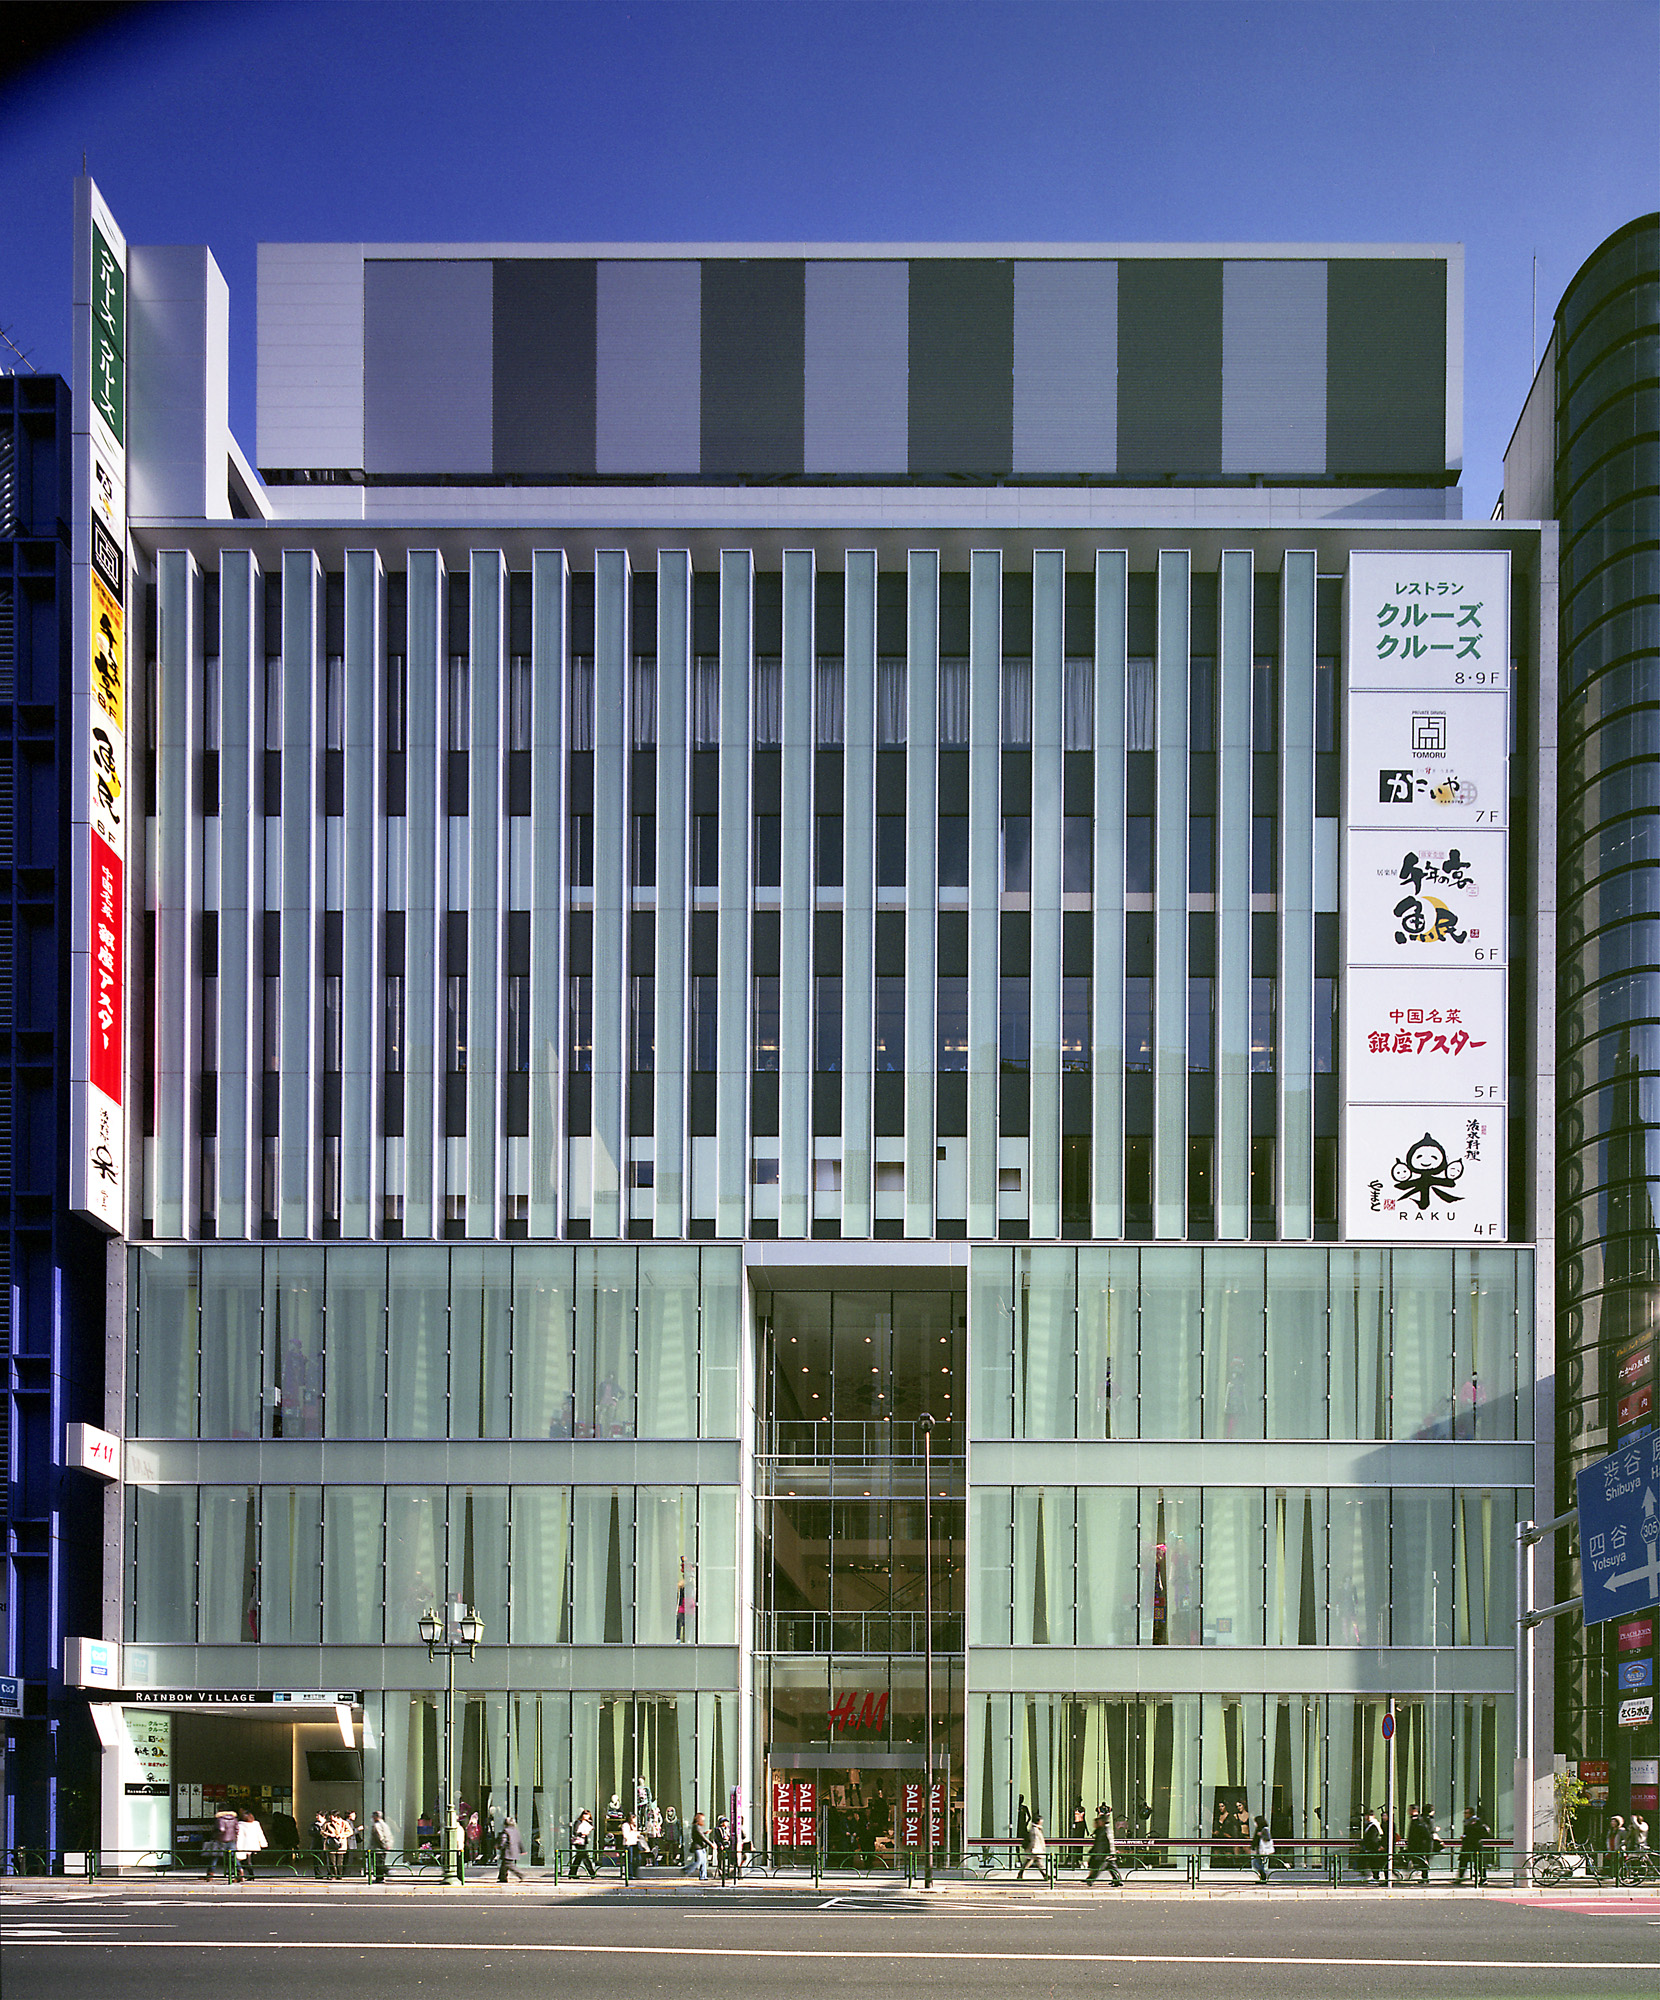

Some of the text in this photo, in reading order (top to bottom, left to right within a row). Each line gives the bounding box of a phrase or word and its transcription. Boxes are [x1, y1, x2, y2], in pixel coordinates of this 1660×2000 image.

[100, 249, 116, 426] クルーズ クルーズ
[1396, 582, 1464, 595] レストラン
[1377, 602, 1484, 628] クルーズ
[1376, 633, 1483, 660] クルーズ
[1393, 895, 1468, 944] 魚民
[1389, 1008, 1463, 1024] 中国名菜
[1367, 1028, 1487, 1056] 銀座アスター
[1399, 1211, 1456, 1220] RAKU
[1603, 1449, 1641, 1488] 渋谷
[1605, 1477, 1641, 1502] Shibuya
[1589, 1524, 1627, 1558] 四谷
[1643, 1521, 1659, 1538] 305
[1592, 1551, 1627, 1572] Yotsuya
[136, 1692, 256, 1702] RAINBOW VILLAGE
[826, 1691, 889, 1732] H&M
[1621, 1705, 1650, 1719] さくら水産
[777, 1784, 789, 1812] SALE
[800, 1784, 812, 1812] SALE
[906, 1784, 918, 1813] SALE
[777, 1817, 789, 1846] SALE
[800, 1817, 812, 1846] SALE
[906, 1817, 918, 1846] SALE
